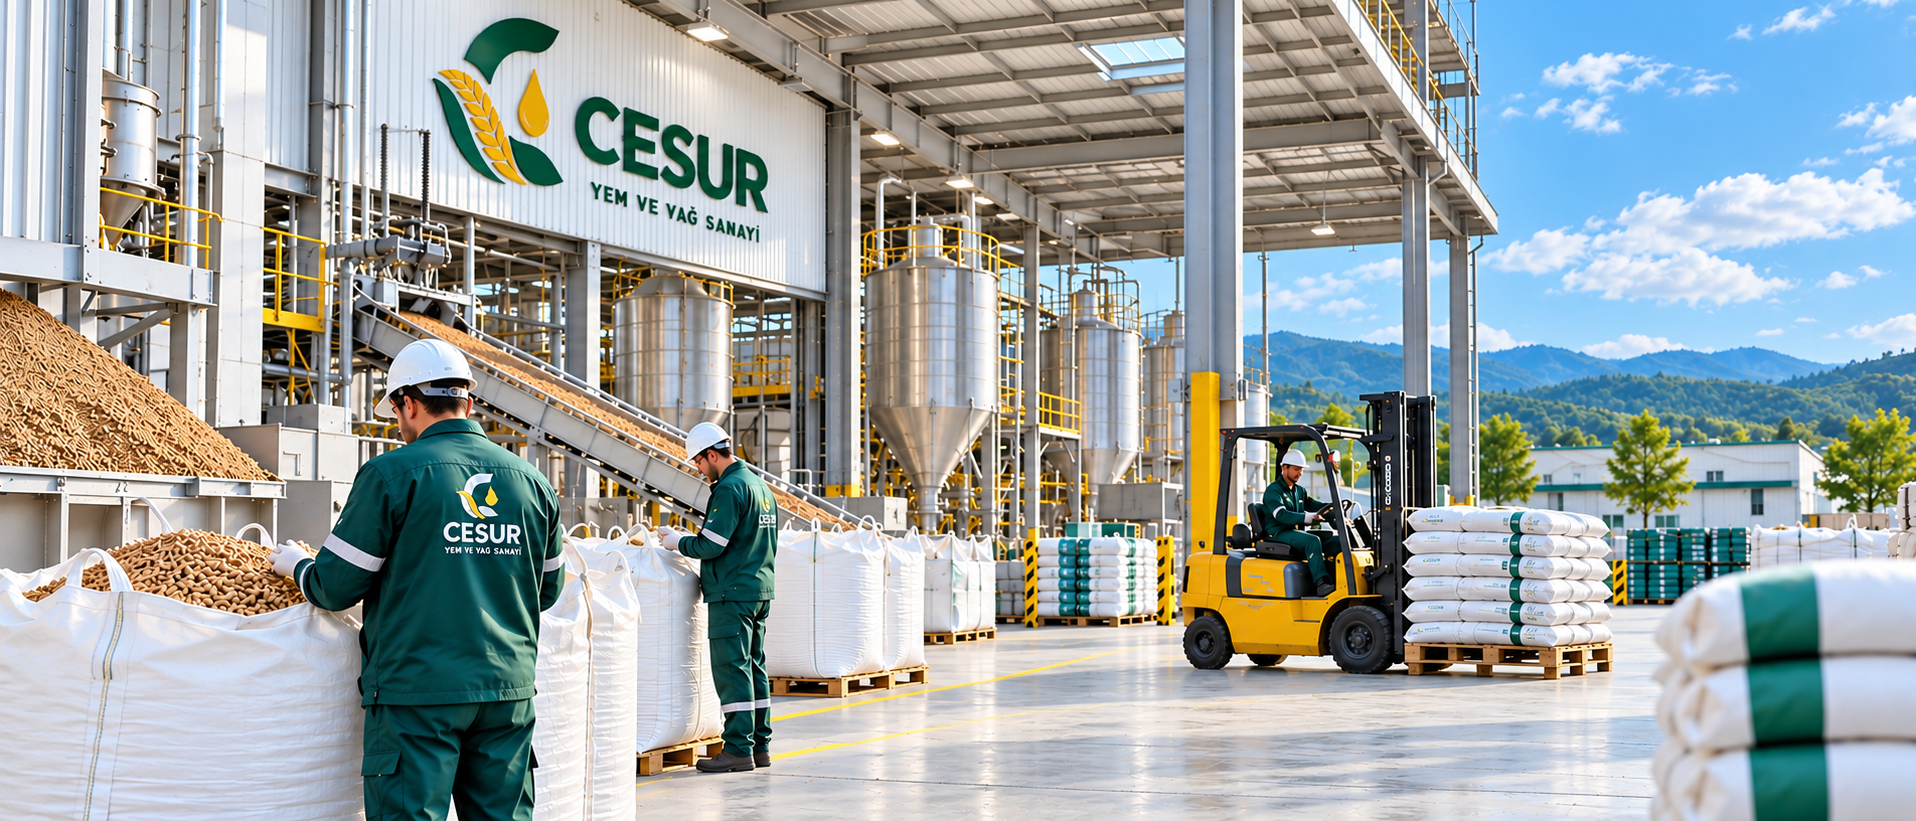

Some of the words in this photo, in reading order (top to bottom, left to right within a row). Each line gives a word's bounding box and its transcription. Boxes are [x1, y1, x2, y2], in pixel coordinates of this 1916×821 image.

[574, 96, 769, 214] CESUR
[591, 181, 628, 208] YEM
[636, 194, 659, 216] VE
[706, 214, 760, 243] SANAYİ
[443, 521, 521, 545] CESUR
[444, 546, 462, 554] YEM
[464, 546, 474, 554] VE
